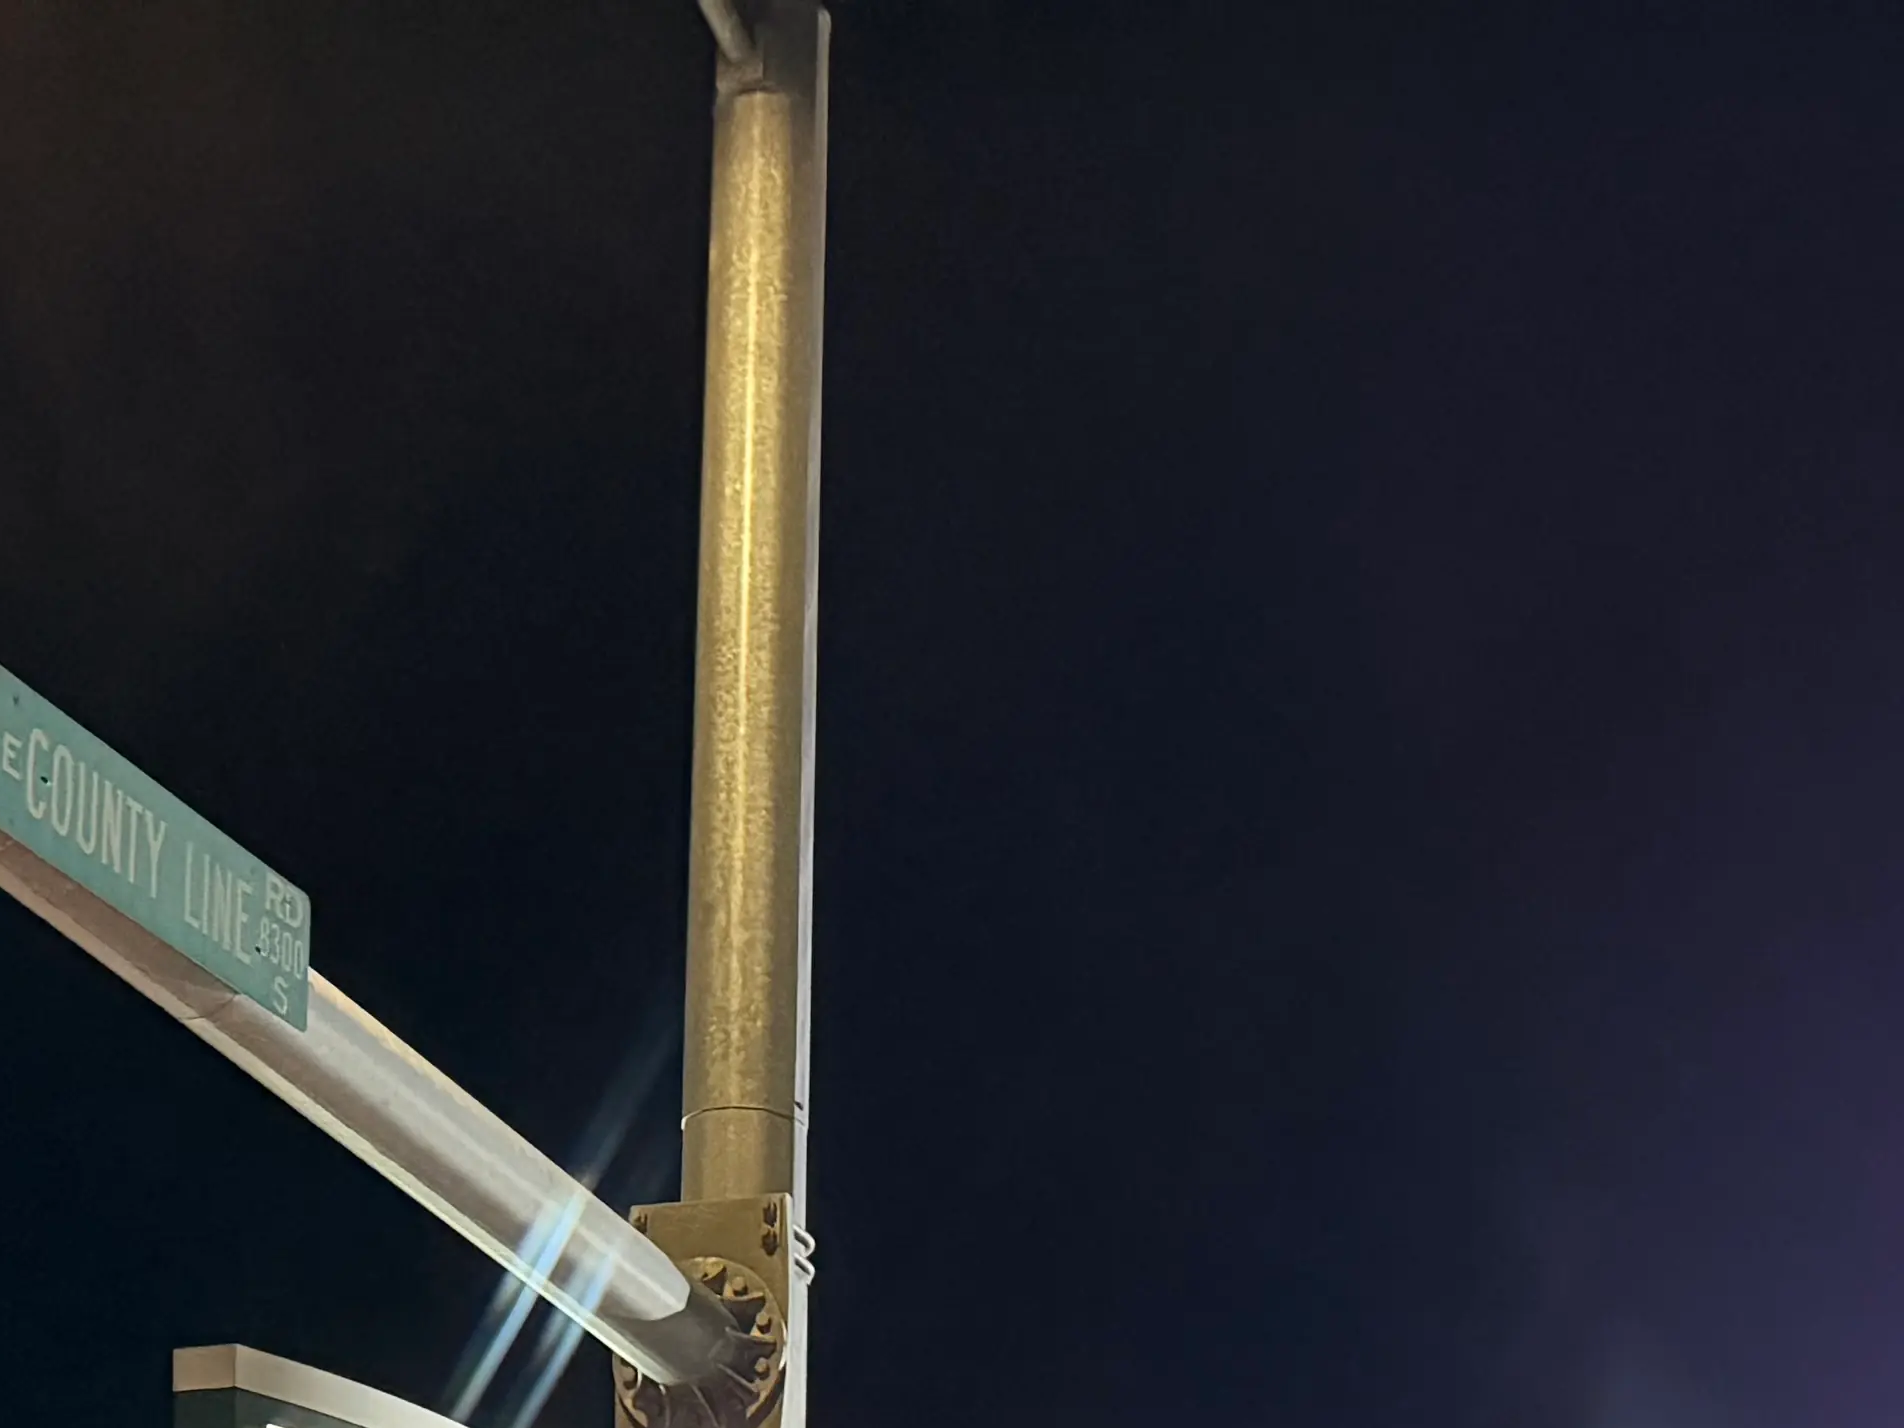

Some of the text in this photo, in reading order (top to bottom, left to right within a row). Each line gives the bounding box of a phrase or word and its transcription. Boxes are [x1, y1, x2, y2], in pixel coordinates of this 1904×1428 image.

[2, 728, 304, 966] E COUNTY LINE RD
[258, 916, 304, 980] 8300
[273, 975, 289, 1015] S
